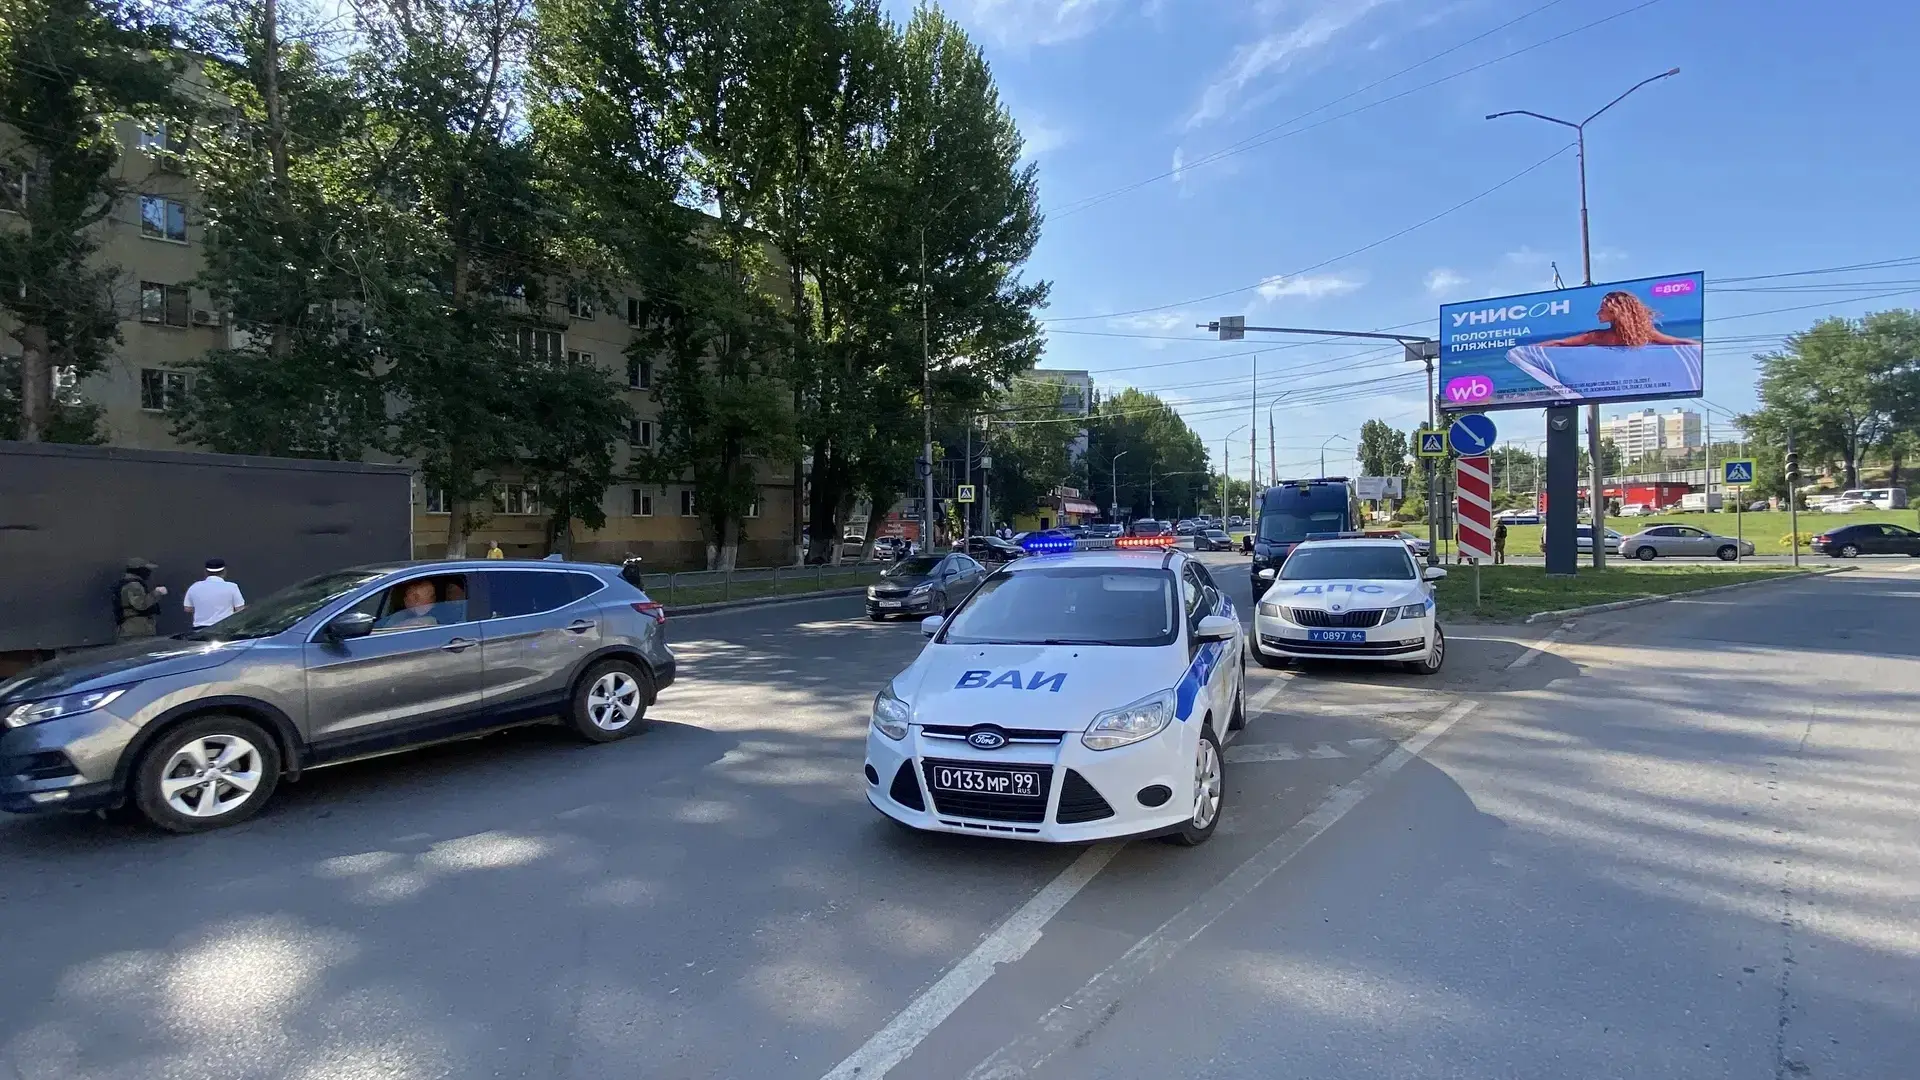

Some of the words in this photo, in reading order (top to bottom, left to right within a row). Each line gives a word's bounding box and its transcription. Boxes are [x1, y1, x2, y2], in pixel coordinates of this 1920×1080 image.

[1451, 299, 1570, 327] УНИСОН
[1451, 326, 1531, 342] ПОЛОТЕНЦА
[1451, 338, 1516, 352] ПЛЯЖНЫЕ
[1451, 380, 1488, 400] wb
[1294, 584, 1385, 595] ДПС
[1322, 631, 1347, 640] 0897
[954, 669, 1068, 692] ВАИ
[975, 735, 996, 745] Ford
[941, 769, 985, 789] 0133
[1014, 774, 1033, 788] 99
